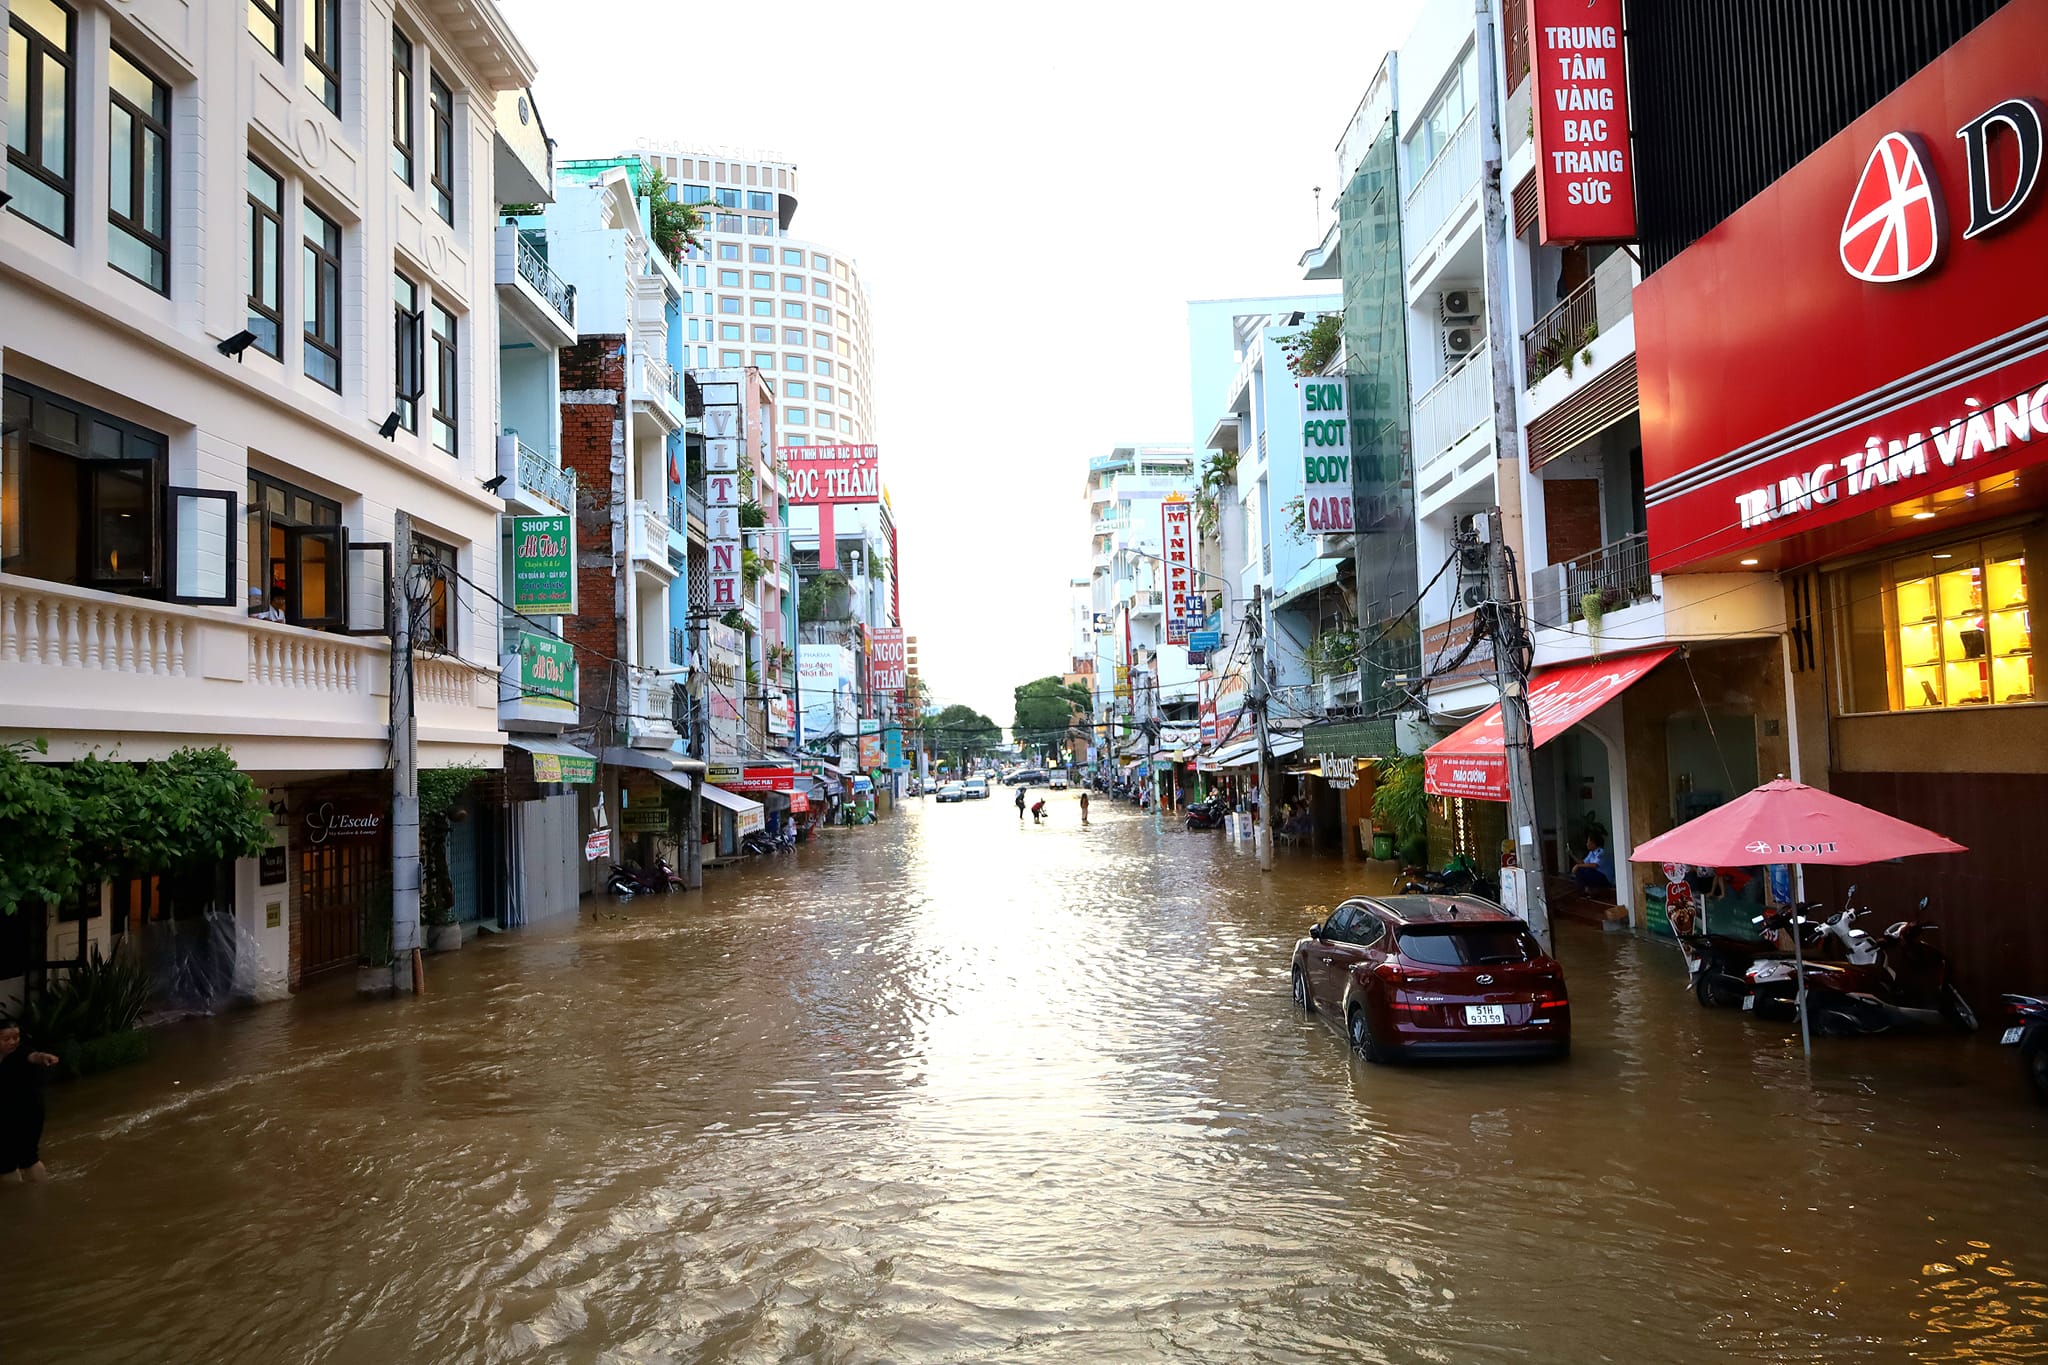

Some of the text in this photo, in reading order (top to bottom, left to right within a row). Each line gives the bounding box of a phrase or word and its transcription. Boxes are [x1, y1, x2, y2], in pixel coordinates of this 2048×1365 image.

[1545, 26, 1617, 49] TRUNG
[1558, 53, 1607, 80] TÂM
[1555, 84, 1614, 111] VÀNG
[1563, 119, 1608, 147] BẠC
[1552, 150, 1623, 174] TRANG
[1567, 177, 1612, 205] SỨC
[1305, 383, 1343, 411] SKIN
[1304, 419, 1346, 447] FOOT
[1305, 455, 1349, 484] BODY
[1735, 463, 1838, 529] TRUNG
[1840, 436, 1928, 496] TÂM
[787, 469, 818, 502] GỌC
[521, 521, 550, 532] SHOP
[1308, 497, 1353, 531] CARE
[1187, 615, 1203, 627] MÁY
[874, 643, 902, 665] NGỌC
[1319, 752, 1356, 787] Mekong
[329, 813, 379, 828] L'Escale
[1778, 842, 1838, 856] DOJI
[1471, 1014, 1500, 1024] 933.59
[1476, 1006, 1493, 1014] 51H
